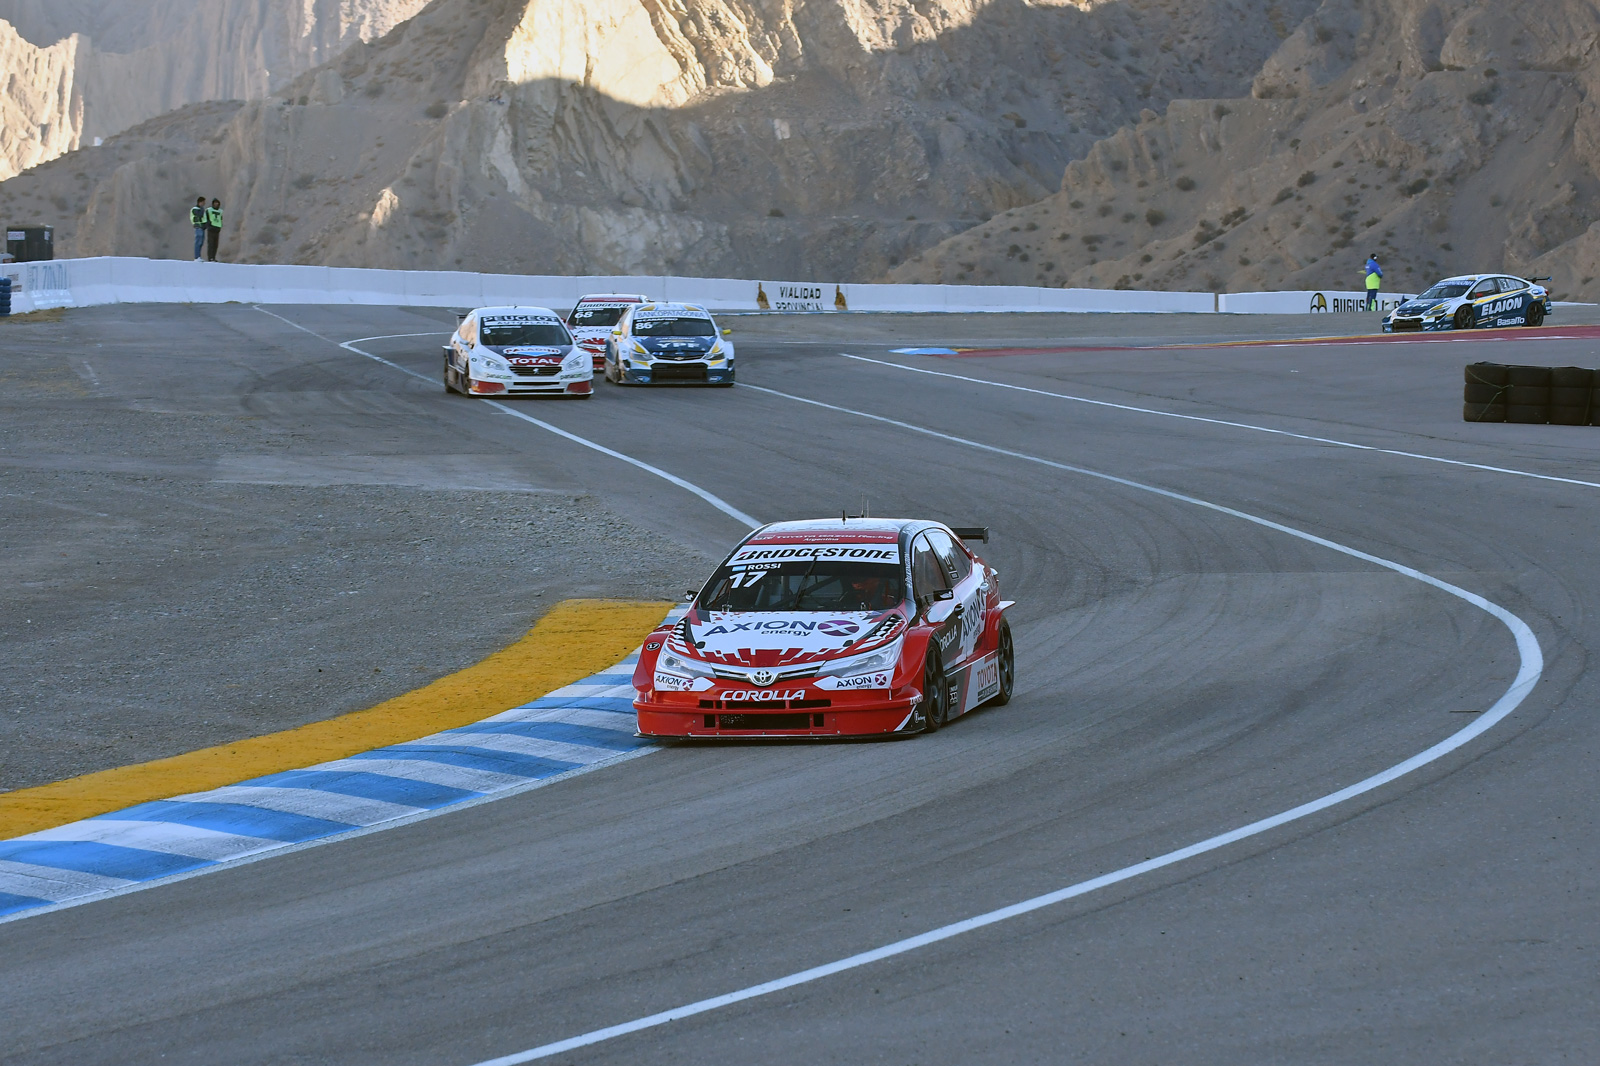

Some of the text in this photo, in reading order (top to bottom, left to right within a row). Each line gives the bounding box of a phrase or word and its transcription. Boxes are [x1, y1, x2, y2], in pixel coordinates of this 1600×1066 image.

[780, 286, 822, 300] VIALIDAD
[1333, 298, 1379, 312] AUGUS
[1481, 297, 1523, 316] ELAION
[574, 311, 594, 319] 68
[734, 547, 897, 562] BRIDGESTONE
[747, 562, 782, 571] ROSSI
[729, 571, 768, 589] 17
[703, 620, 818, 637] AXION
[760, 629, 811, 637] energy
[940, 625, 958, 652] OROLLA
[648, 642, 661, 650] 17
[655, 675, 682, 686] AXION
[977, 662, 998, 688] TOYOTA
[836, 676, 872, 689] AXION
[720, 689, 806, 702] COROLLA
